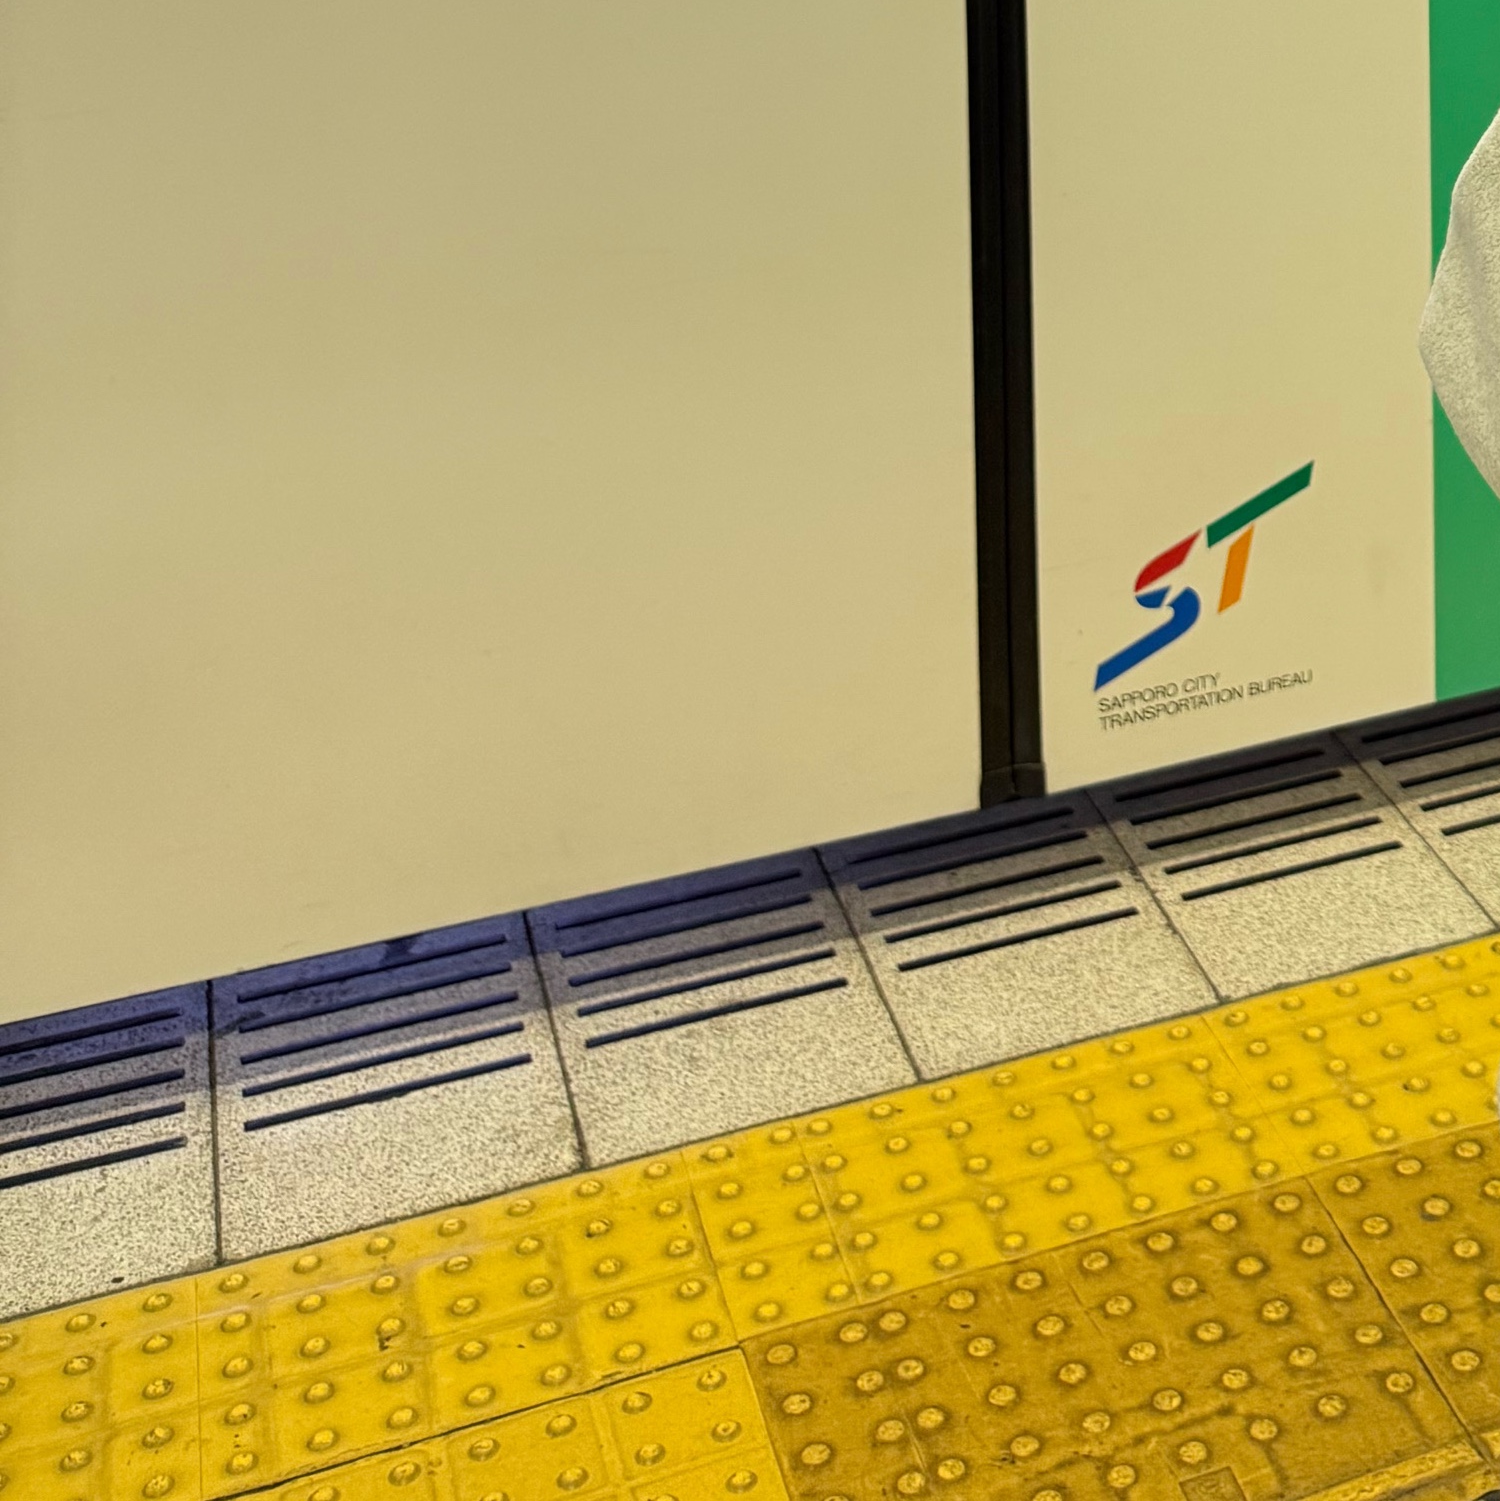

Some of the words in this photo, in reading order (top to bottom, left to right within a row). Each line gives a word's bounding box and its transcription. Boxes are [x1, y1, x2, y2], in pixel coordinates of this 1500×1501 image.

[1099, 680, 1178, 713] SAPPORO
[1182, 671, 1221, 694] CITY
[1100, 685, 1243, 731] TRANSPORTATION
[1248, 668, 1314, 696] BUREAU
